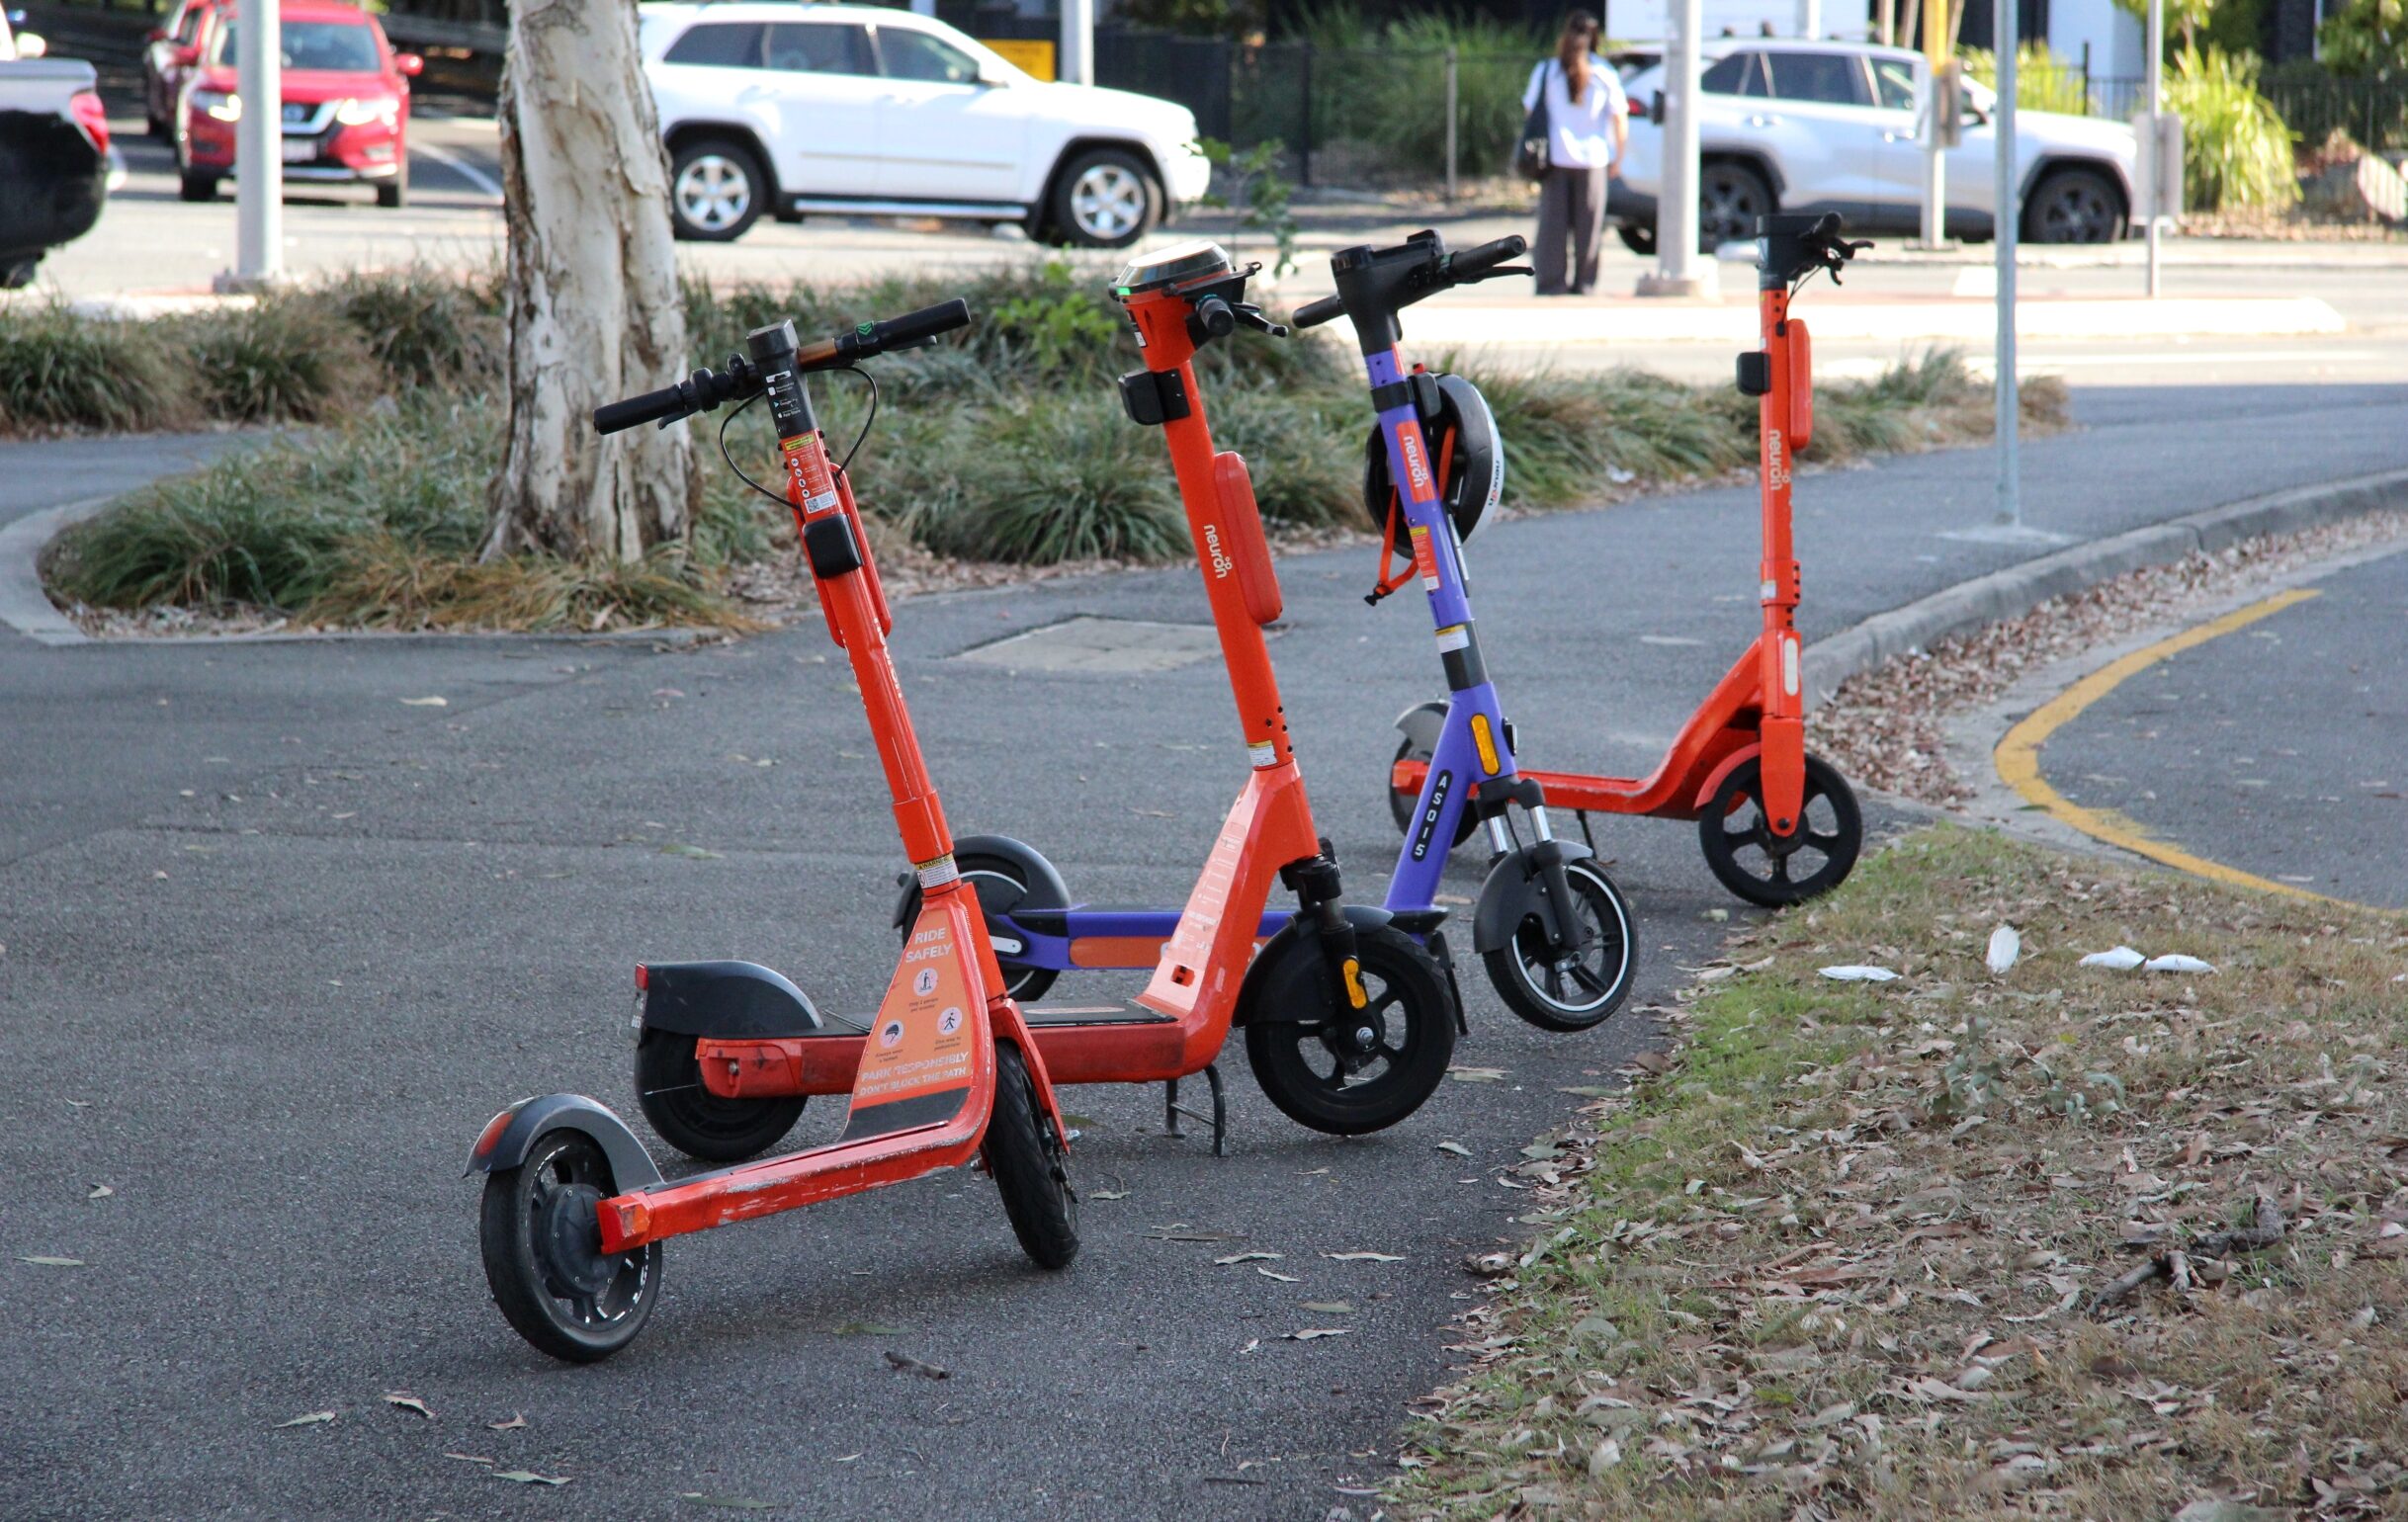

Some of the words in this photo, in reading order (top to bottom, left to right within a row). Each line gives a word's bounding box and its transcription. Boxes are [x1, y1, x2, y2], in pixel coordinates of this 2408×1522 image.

[1403, 435, 1428, 488] neuron
[1768, 429, 1790, 491] neuron
[1203, 524, 1232, 579] neuron
[914, 927, 946, 945] RIDE
[904, 942, 954, 964] SAFELY
[859, 1082, 891, 1097] DON'T
[922, 1072, 942, 1083] THE
[861, 1066, 893, 1082] PARK
